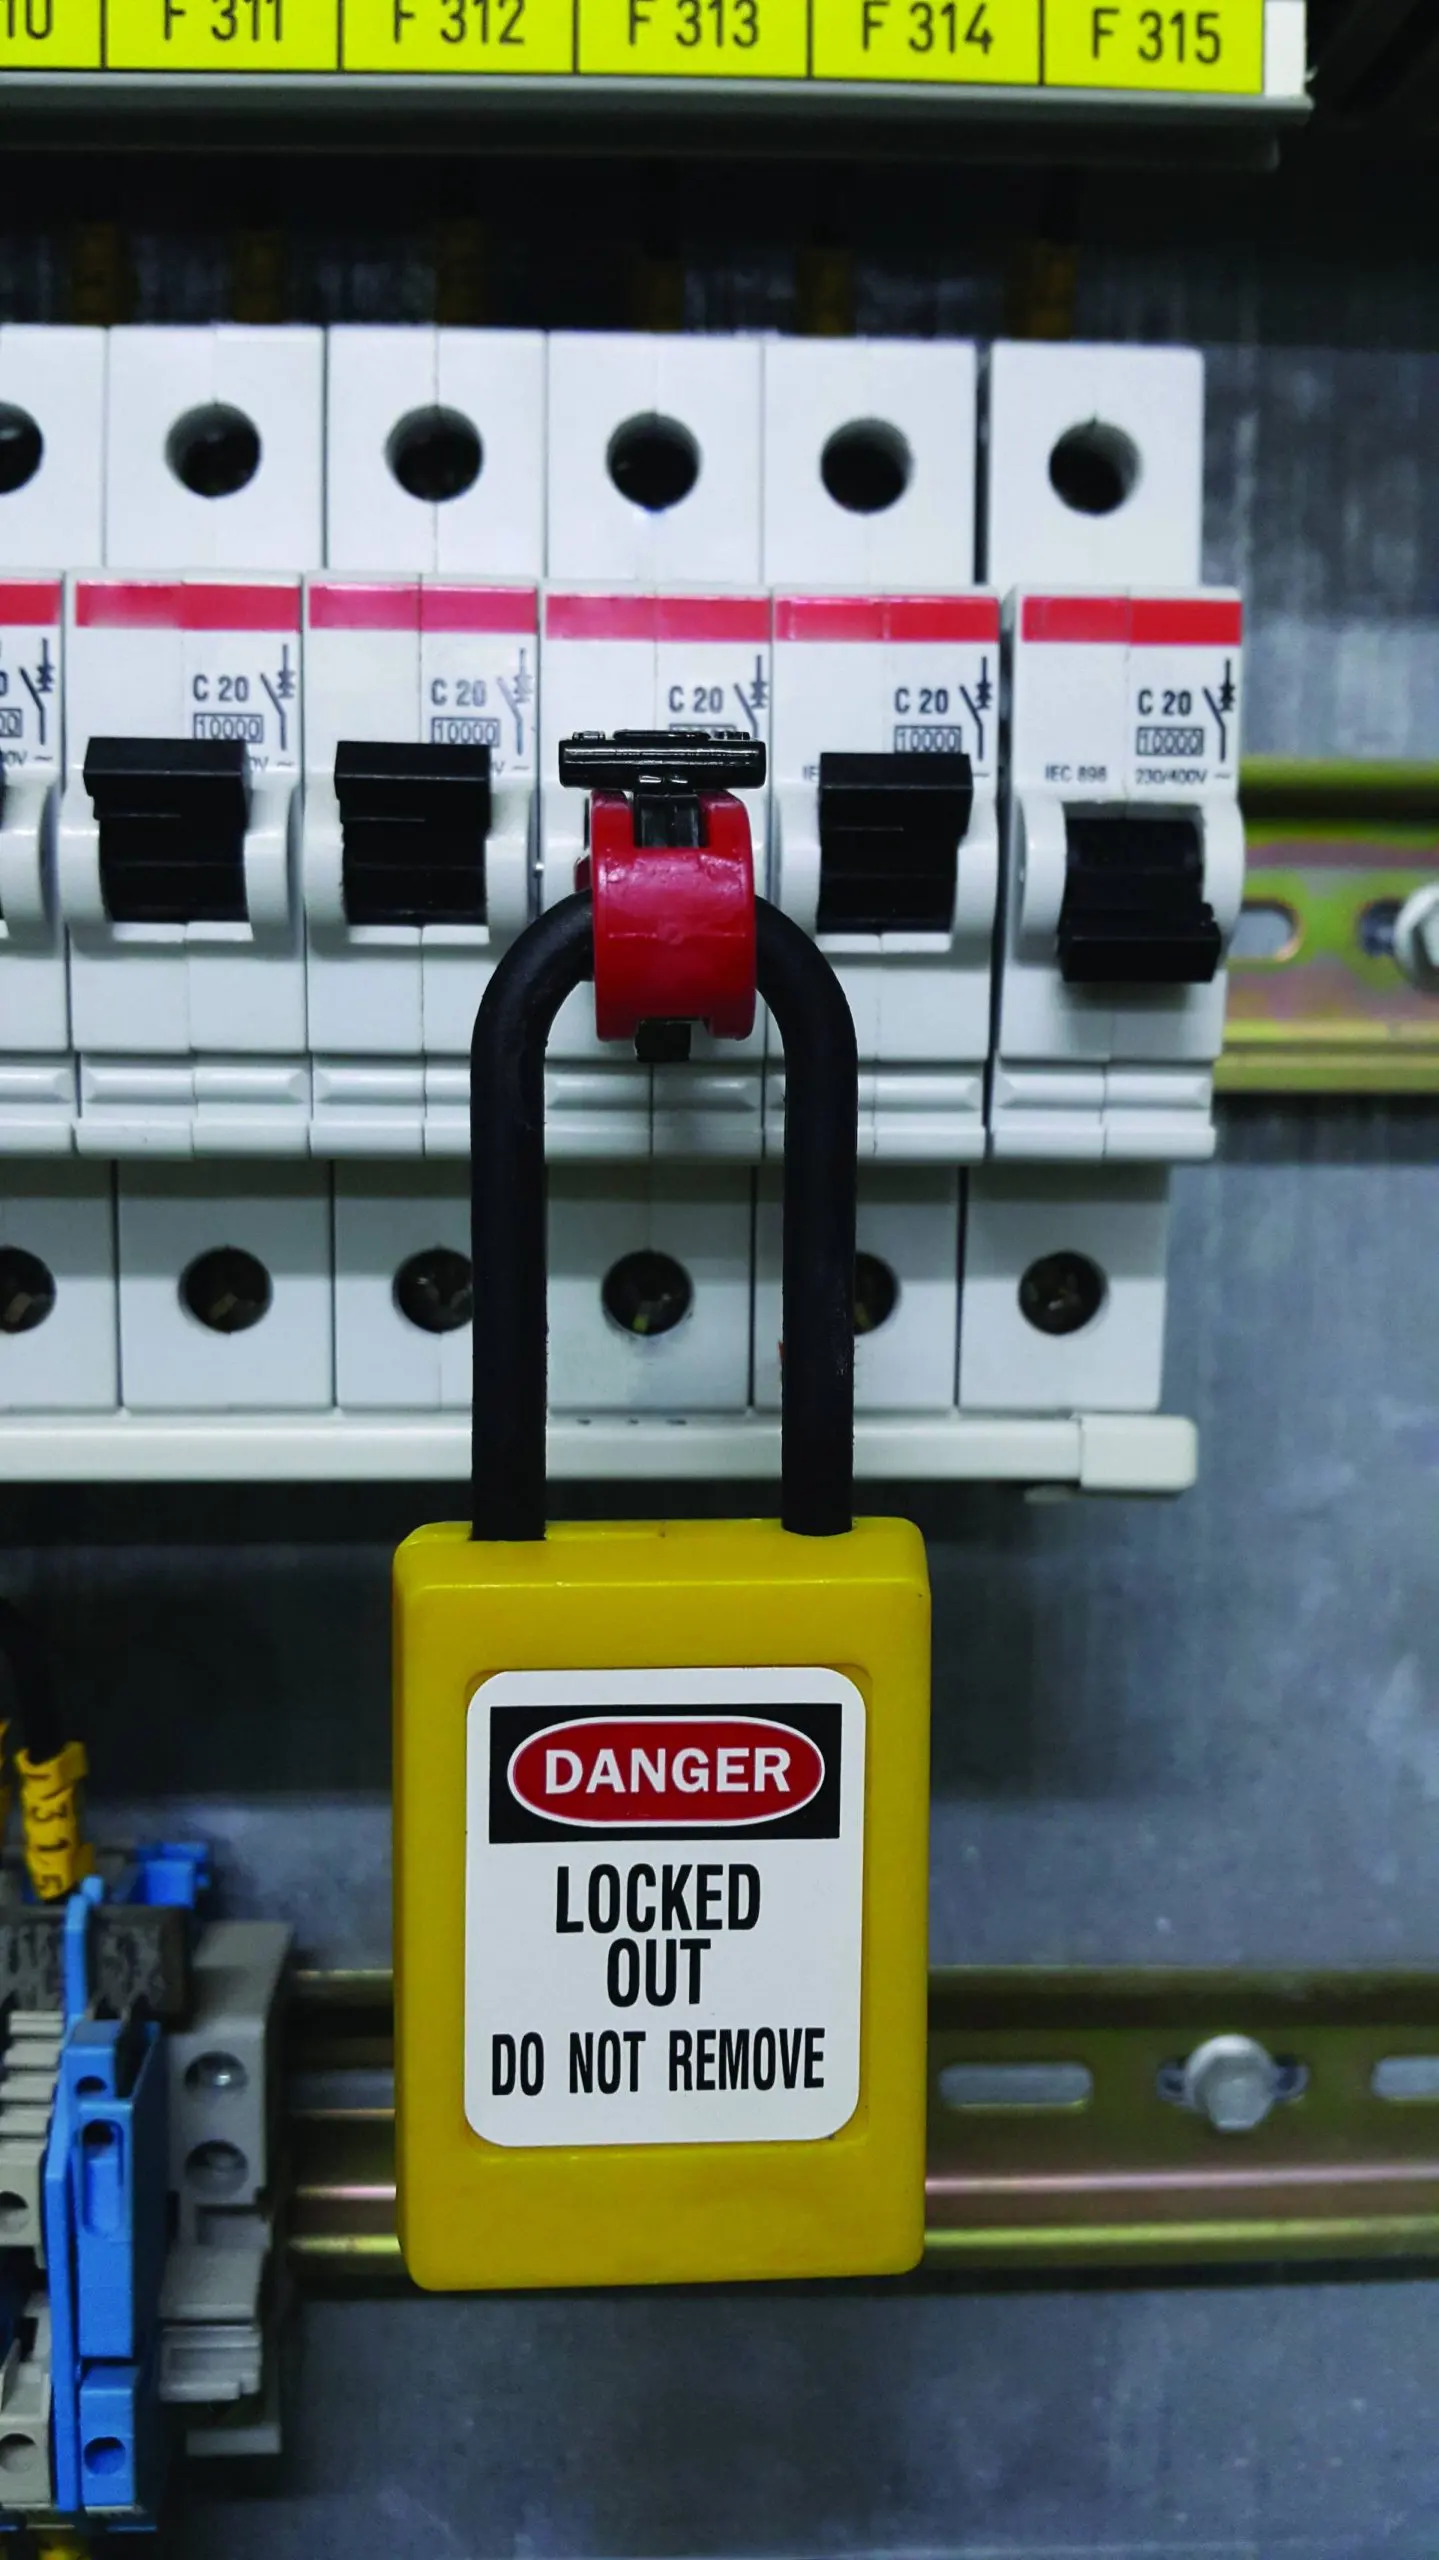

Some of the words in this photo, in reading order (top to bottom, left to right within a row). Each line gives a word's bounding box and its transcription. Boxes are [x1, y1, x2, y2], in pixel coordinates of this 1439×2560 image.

[164, 0, 185, 40] F
[211, 0, 283, 42] 311
[394, 0, 416, 43] F
[440, 0, 524, 44] 312
[628, 0, 650, 46] F
[675, 0, 760, 48] 313
[862, 1, 888, 50] F
[908, 1, 994, 54] 314
[1092, 8, 1118, 59] F
[1138, 10, 1222, 64] 315
[193, 674, 208, 701] C
[218, 676, 249, 701] 20
[431, 679, 447, 706] C
[456, 680, 486, 706] 20
[669, 686, 684, 713] C
[693, 687, 723, 714] 20
[894, 688, 910, 714] C
[919, 689, 949, 714] 20
[1138, 689, 1153, 716] C
[1162, 689, 1192, 716] 20
[1139, 729, 1201, 755] 10000
[1045, 765, 1072, 781] IEC
[544, 1747, 792, 1794] DANGER
[556, 1863, 761, 1934] LOCKED
[606, 1937, 712, 2008] OUT
[491, 2032, 545, 2096] DO
[569, 2030, 647, 2094] NOT
[668, 2027, 826, 2092] REMOVE
